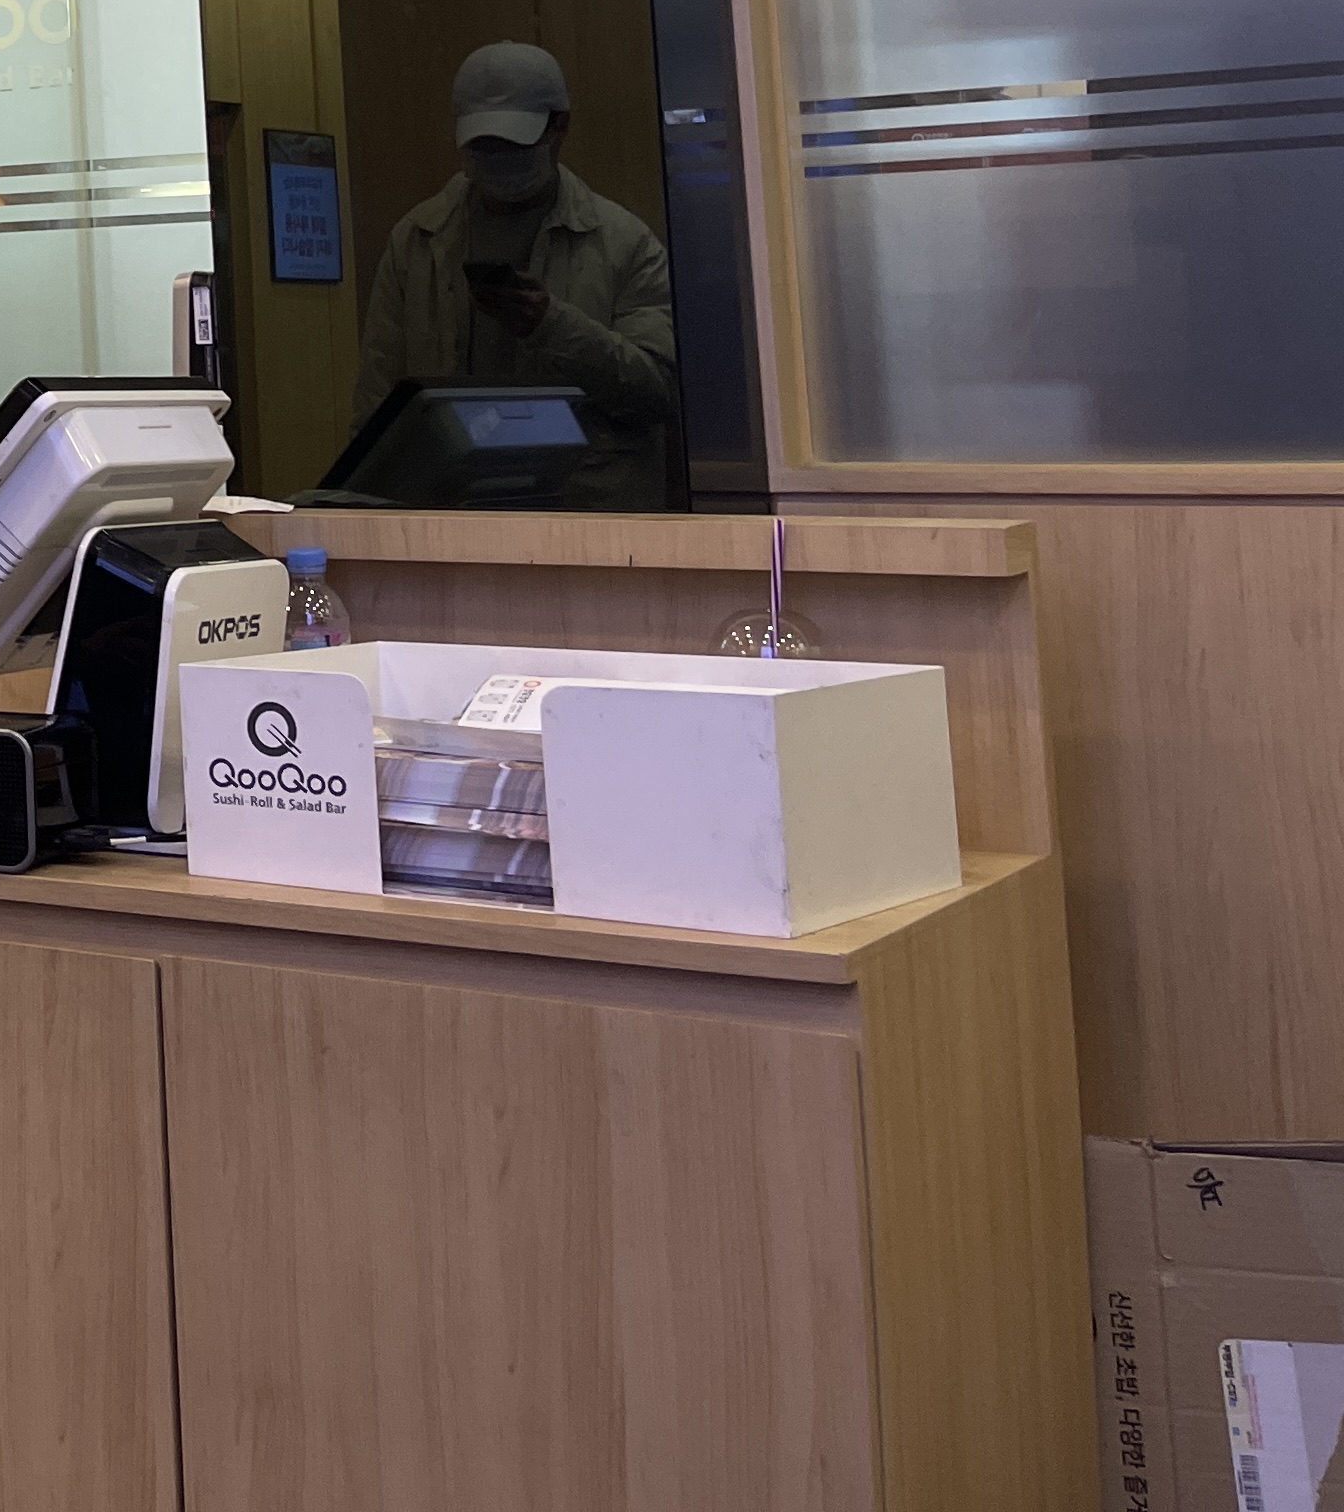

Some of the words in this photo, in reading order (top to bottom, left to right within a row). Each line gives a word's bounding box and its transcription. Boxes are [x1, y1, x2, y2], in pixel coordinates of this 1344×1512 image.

[198, 613, 261, 645] OKPOS
[209, 757, 348, 798] QooQoo
[276, 798, 286, 810] &
[288, 798, 322, 813] Salad
[325, 801, 348, 815] Bar
[1108, 1291, 1135, 1350] 신선한
[1118, 1407, 1148, 1470] 다양한
